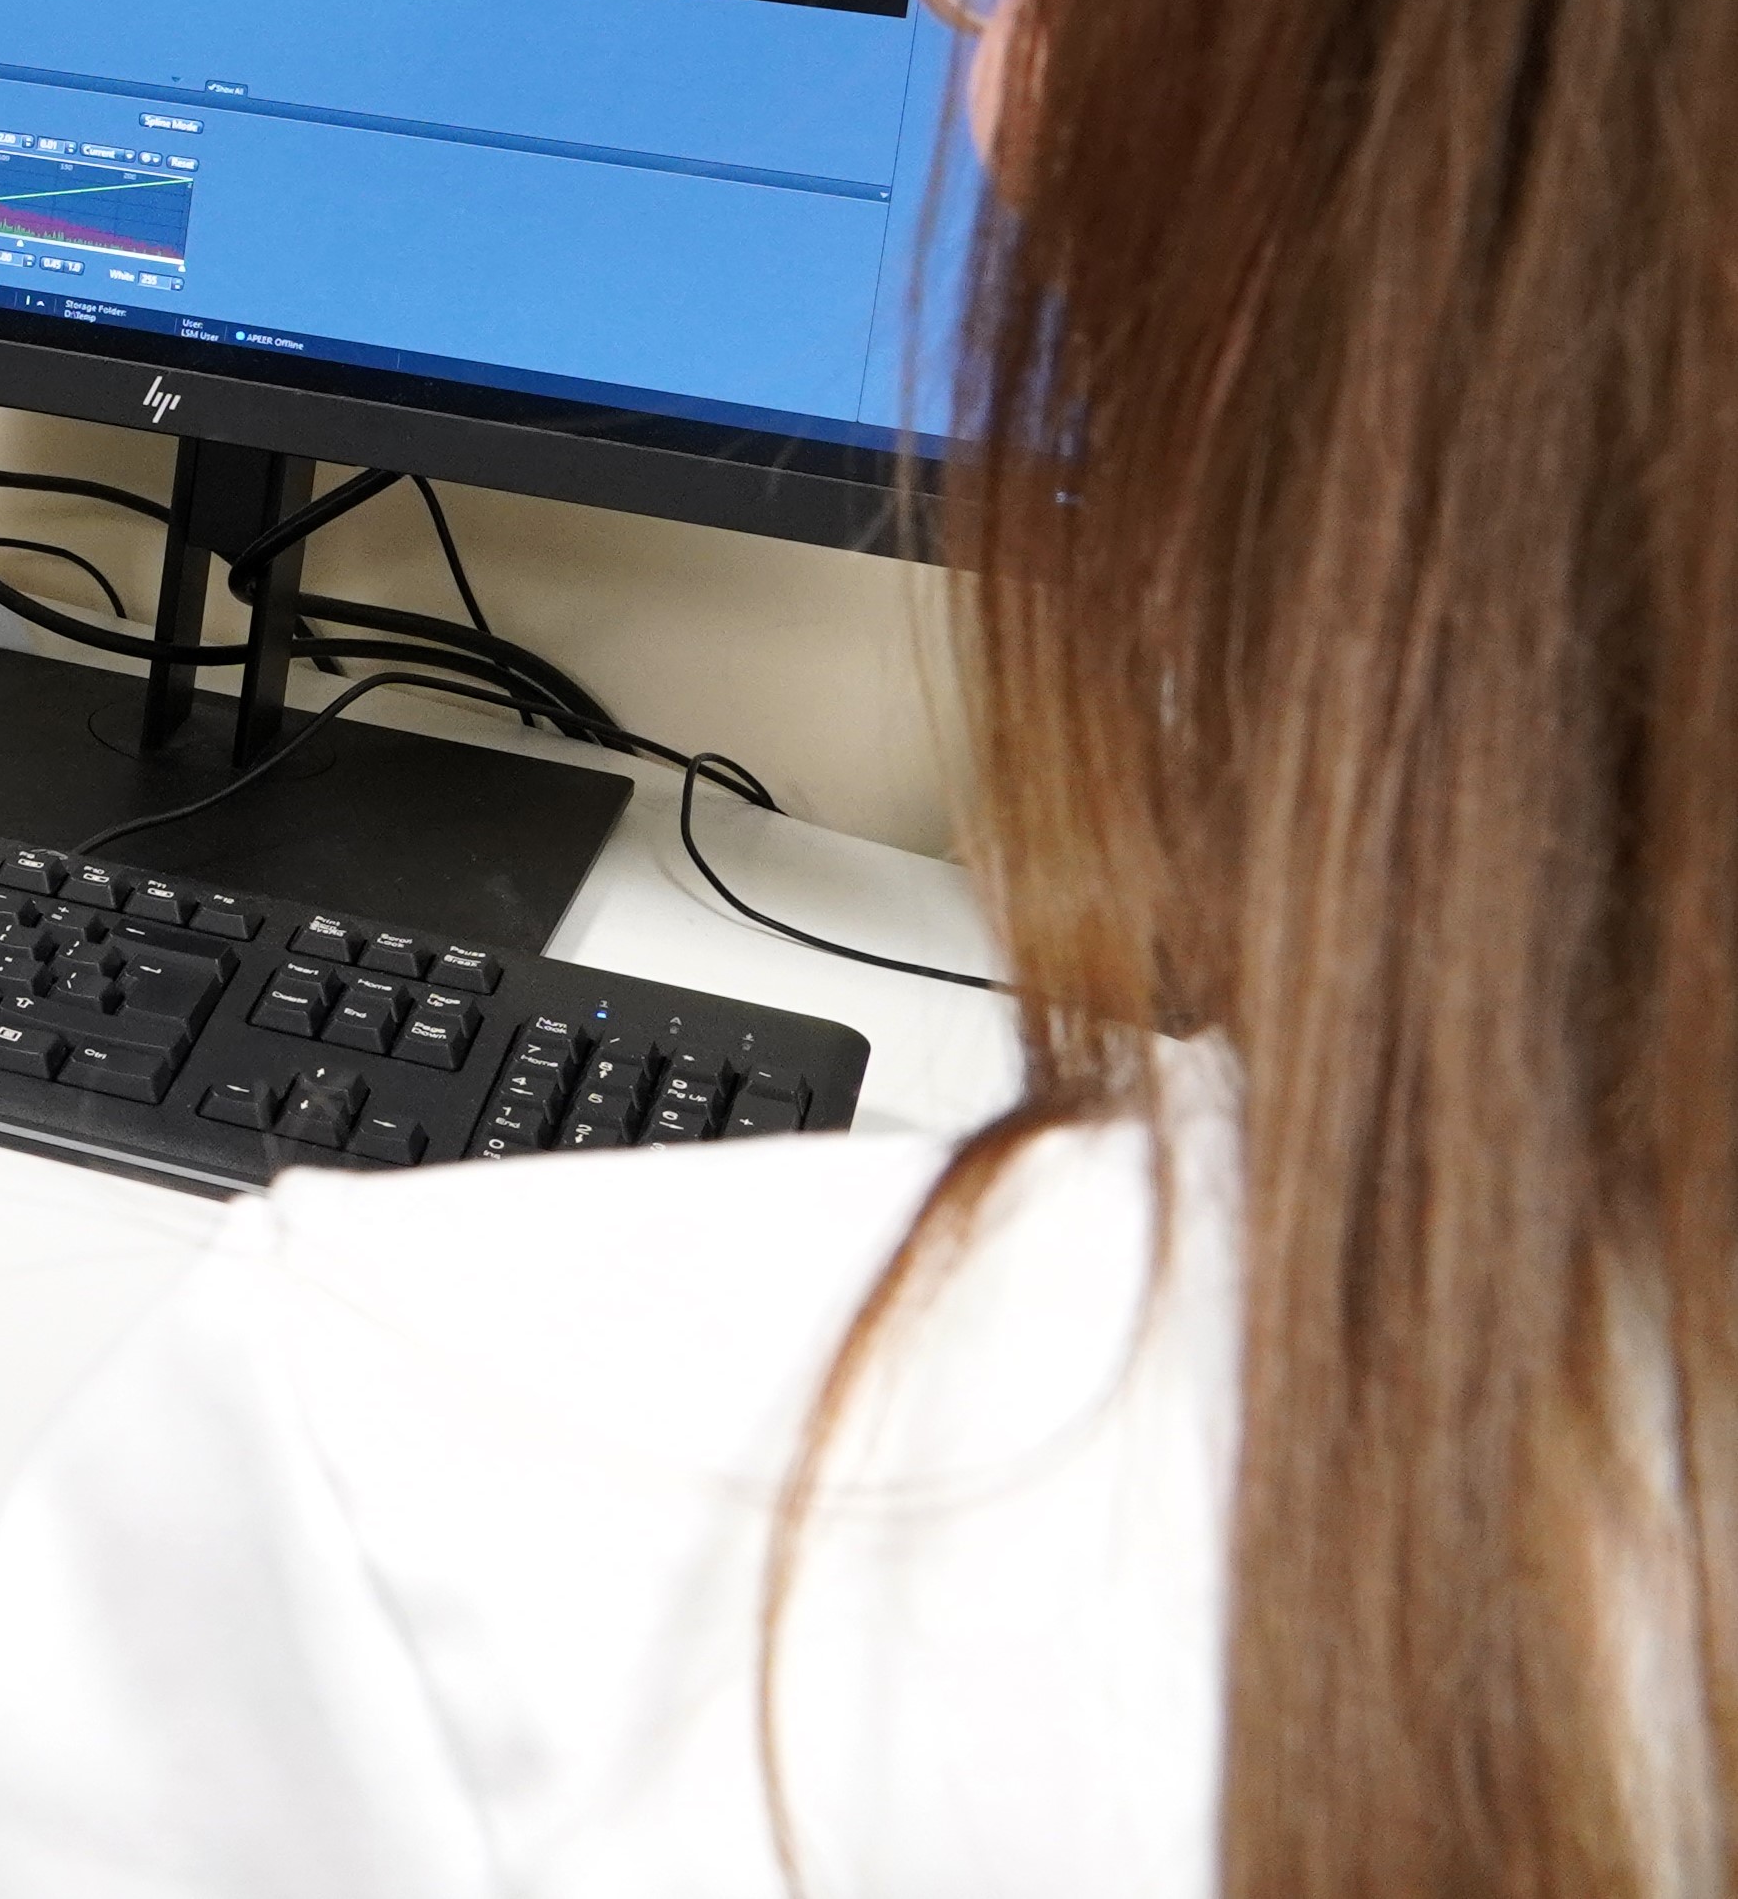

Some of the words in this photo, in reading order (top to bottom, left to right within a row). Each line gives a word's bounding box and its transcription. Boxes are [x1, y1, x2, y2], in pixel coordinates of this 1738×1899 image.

[143, 115, 170, 130] Spline
[171, 119, 199, 133] Mode
[83, 145, 116, 159] Current
[109, 269, 135, 282] White
[141, 274, 157, 285] 255
[65, 299, 97, 313] Storage
[98, 304, 126, 317] Folder:
[182, 319, 204, 330] User:
[181, 329, 199, 339] LSM
[200, 331, 219, 342] User
[274, 337, 304, 351] Offline
[450, 945, 486, 958] Pause
[287, 962, 319, 975] Insert
[357, 978, 392, 991] Home
[271, 991, 309, 1004] Delete
[343, 1007, 367, 1019] End
[84, 1048, 107, 1060] Ctrl
[520, 1053, 559, 1068] Home
[495, 1116, 521, 1129] End
